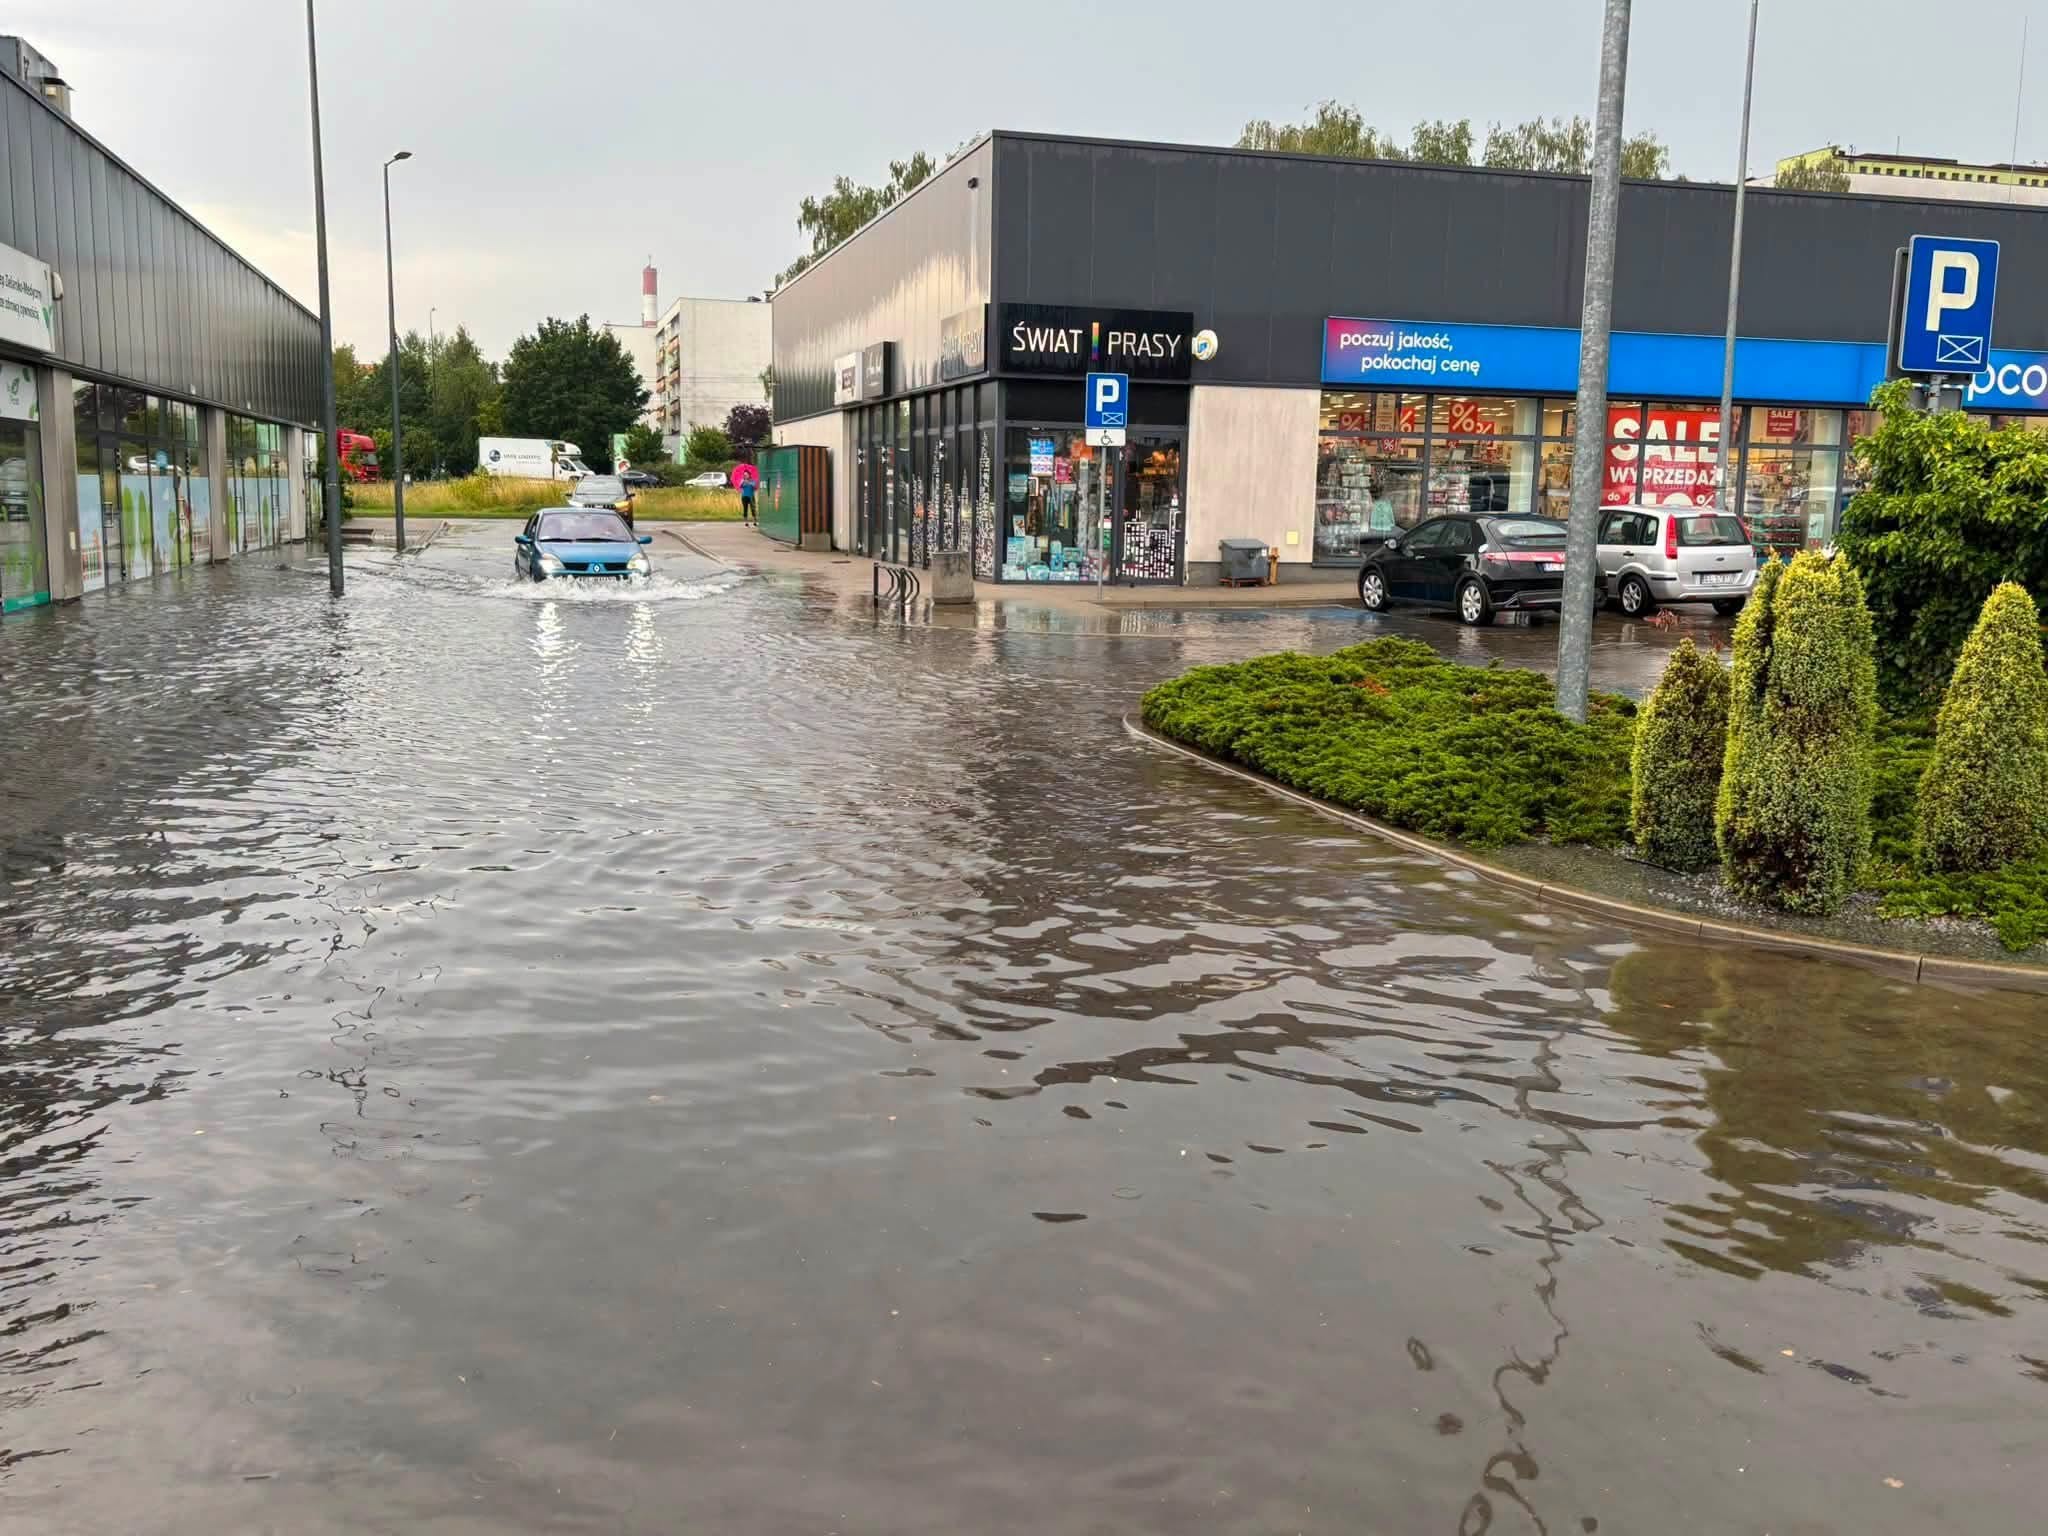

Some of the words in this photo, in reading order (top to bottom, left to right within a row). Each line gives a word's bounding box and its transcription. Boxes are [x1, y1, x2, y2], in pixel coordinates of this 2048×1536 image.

[1925, 250, 1980, 332] P
[1012, 321, 1083, 354] ŚWIAT
[1107, 331, 1181, 358] PRASY
[1340, 331, 1394, 351] poczuj
[1397, 331, 1453, 352] jakość,
[1361, 353, 1437, 375] pokochaj
[1441, 359, 1480, 376] cenę
[1096, 378, 1119, 412] P
[1770, 410, 1793, 419] SALE
[1611, 417, 1720, 463] SALE
[1609, 465, 1724, 486] WYPRZEDAŻ
[1607, 492, 1620, 501] do
